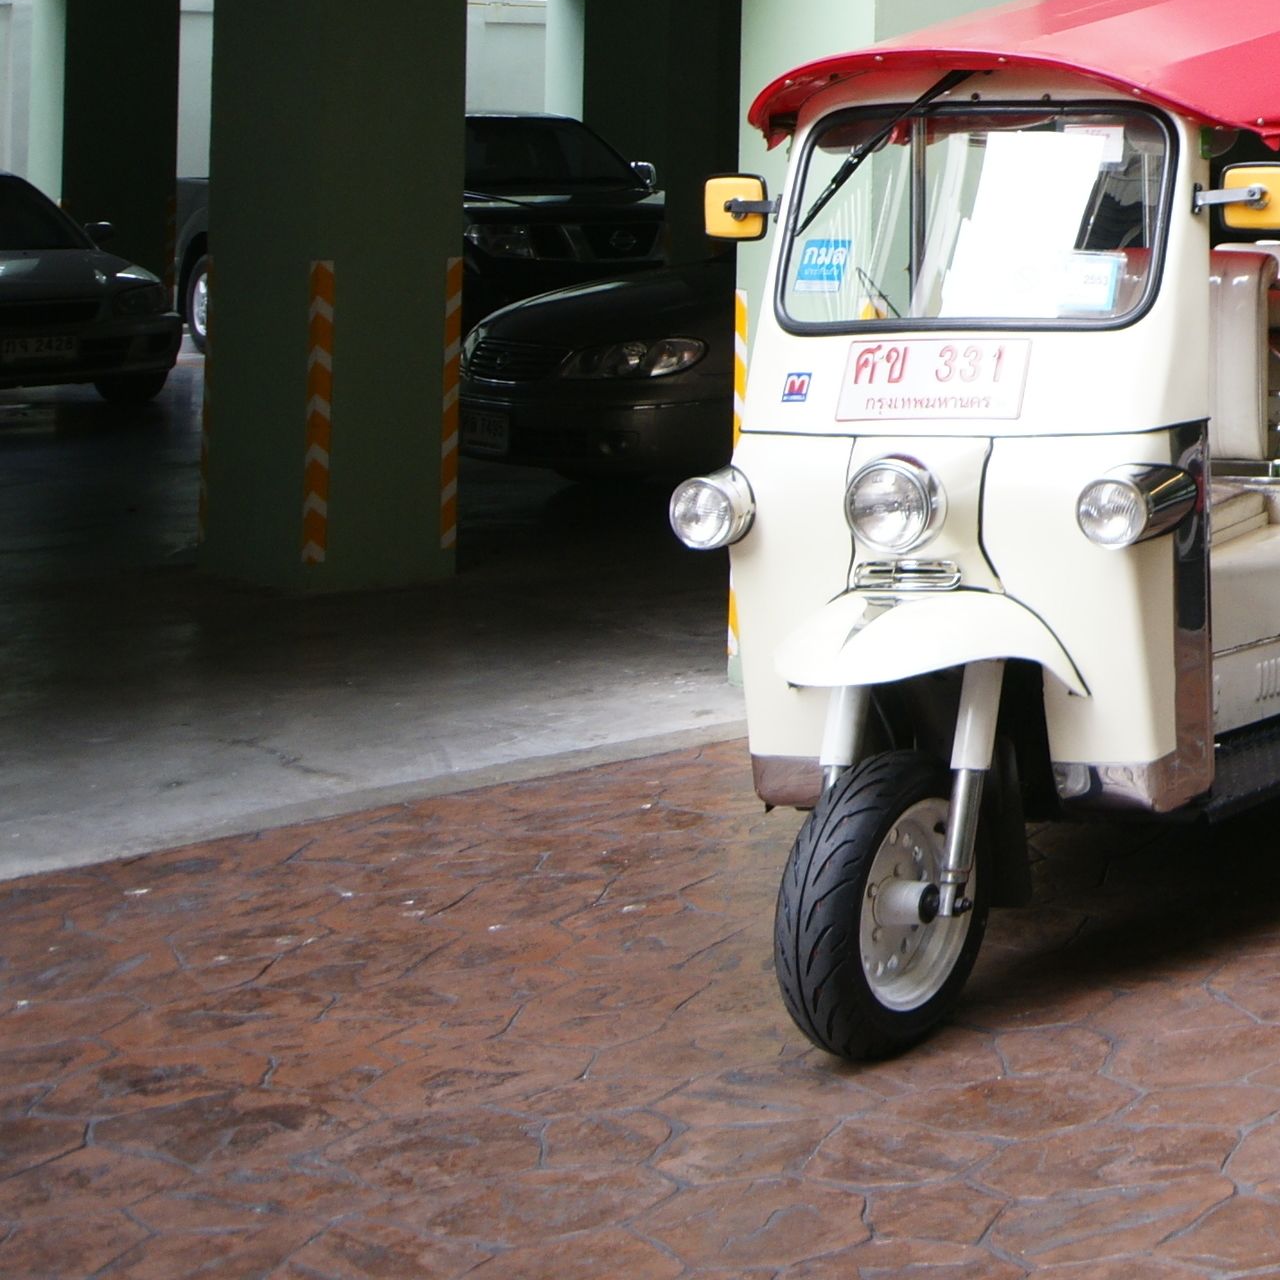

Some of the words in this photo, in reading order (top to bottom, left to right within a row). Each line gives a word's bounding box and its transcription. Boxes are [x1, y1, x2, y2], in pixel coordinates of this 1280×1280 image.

[935, 345, 1005, 383] 331
[865, 395, 993, 415] กรุงเทพมหานคร
